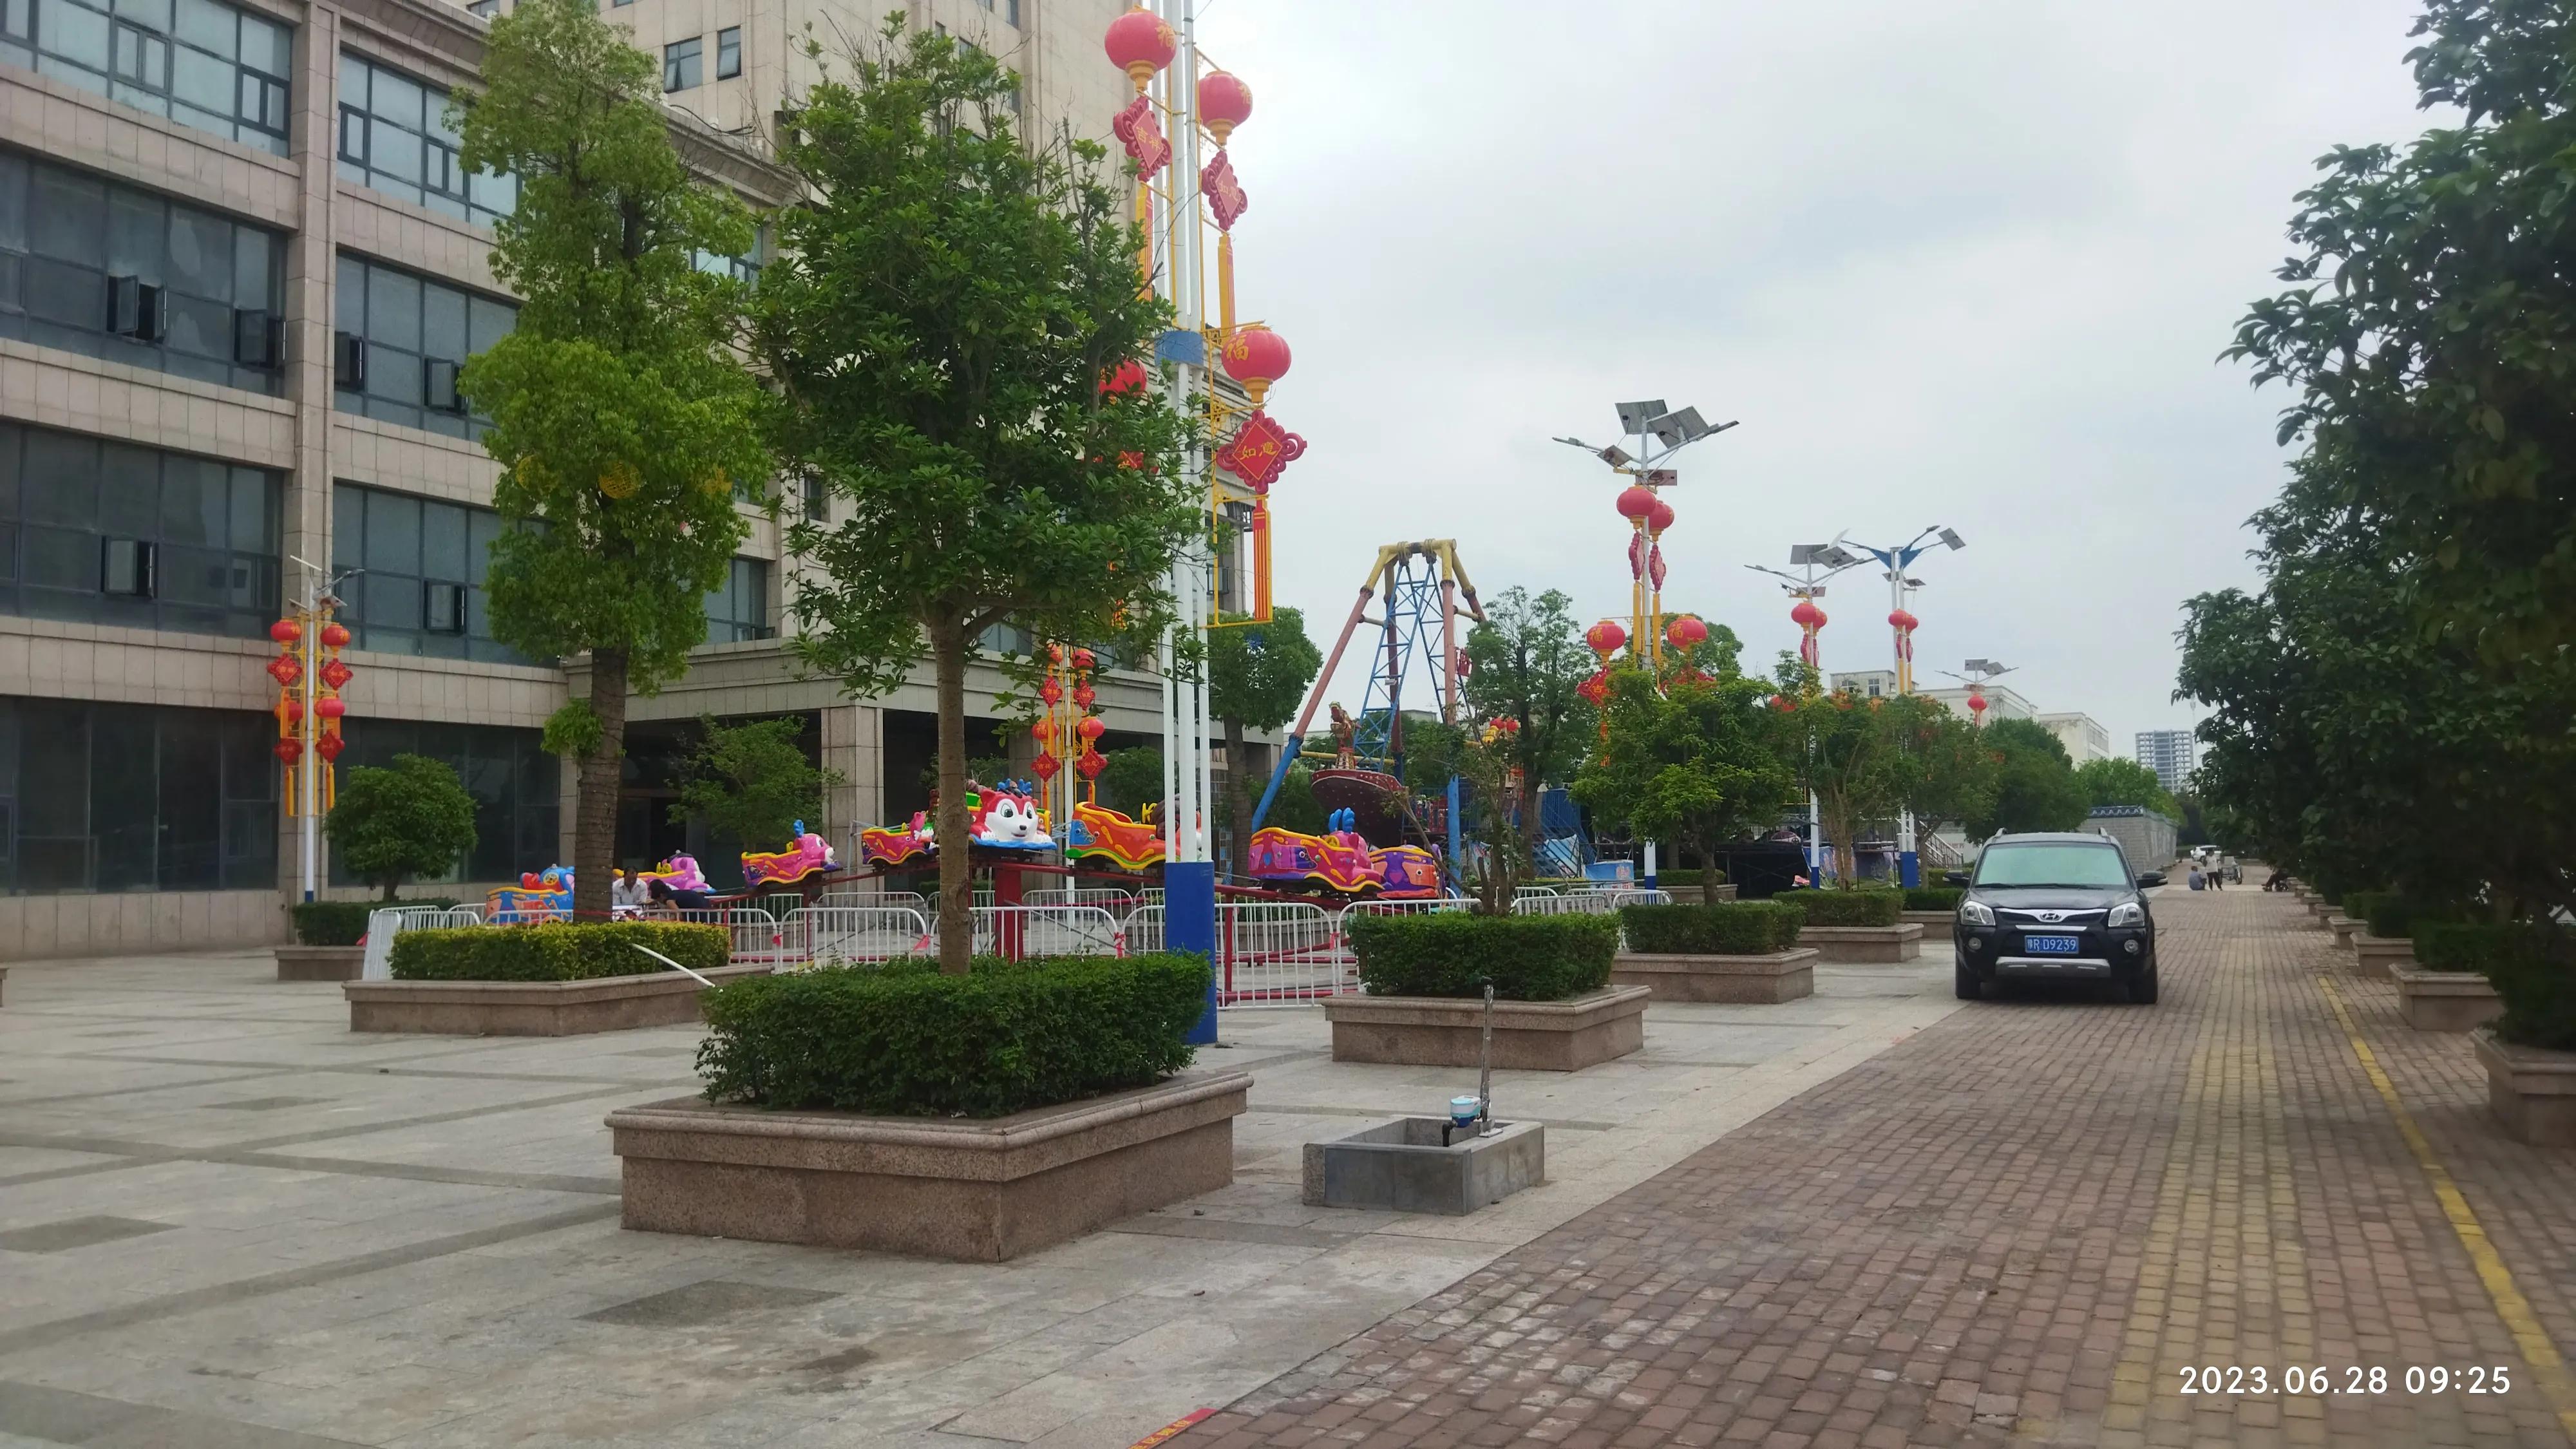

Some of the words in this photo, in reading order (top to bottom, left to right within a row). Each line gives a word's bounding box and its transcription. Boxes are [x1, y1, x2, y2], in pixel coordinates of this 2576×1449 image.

[1136, 126, 1160, 153] 吉祥
[1226, 334, 1249, 364] 福
[1239, 441, 1278, 461] 如意
[1589, 626, 1604, 643] 福
[1669, 623, 1684, 639] 福
[1036, 723, 1048, 735] 福
[1079, 719, 1090, 733] 福
